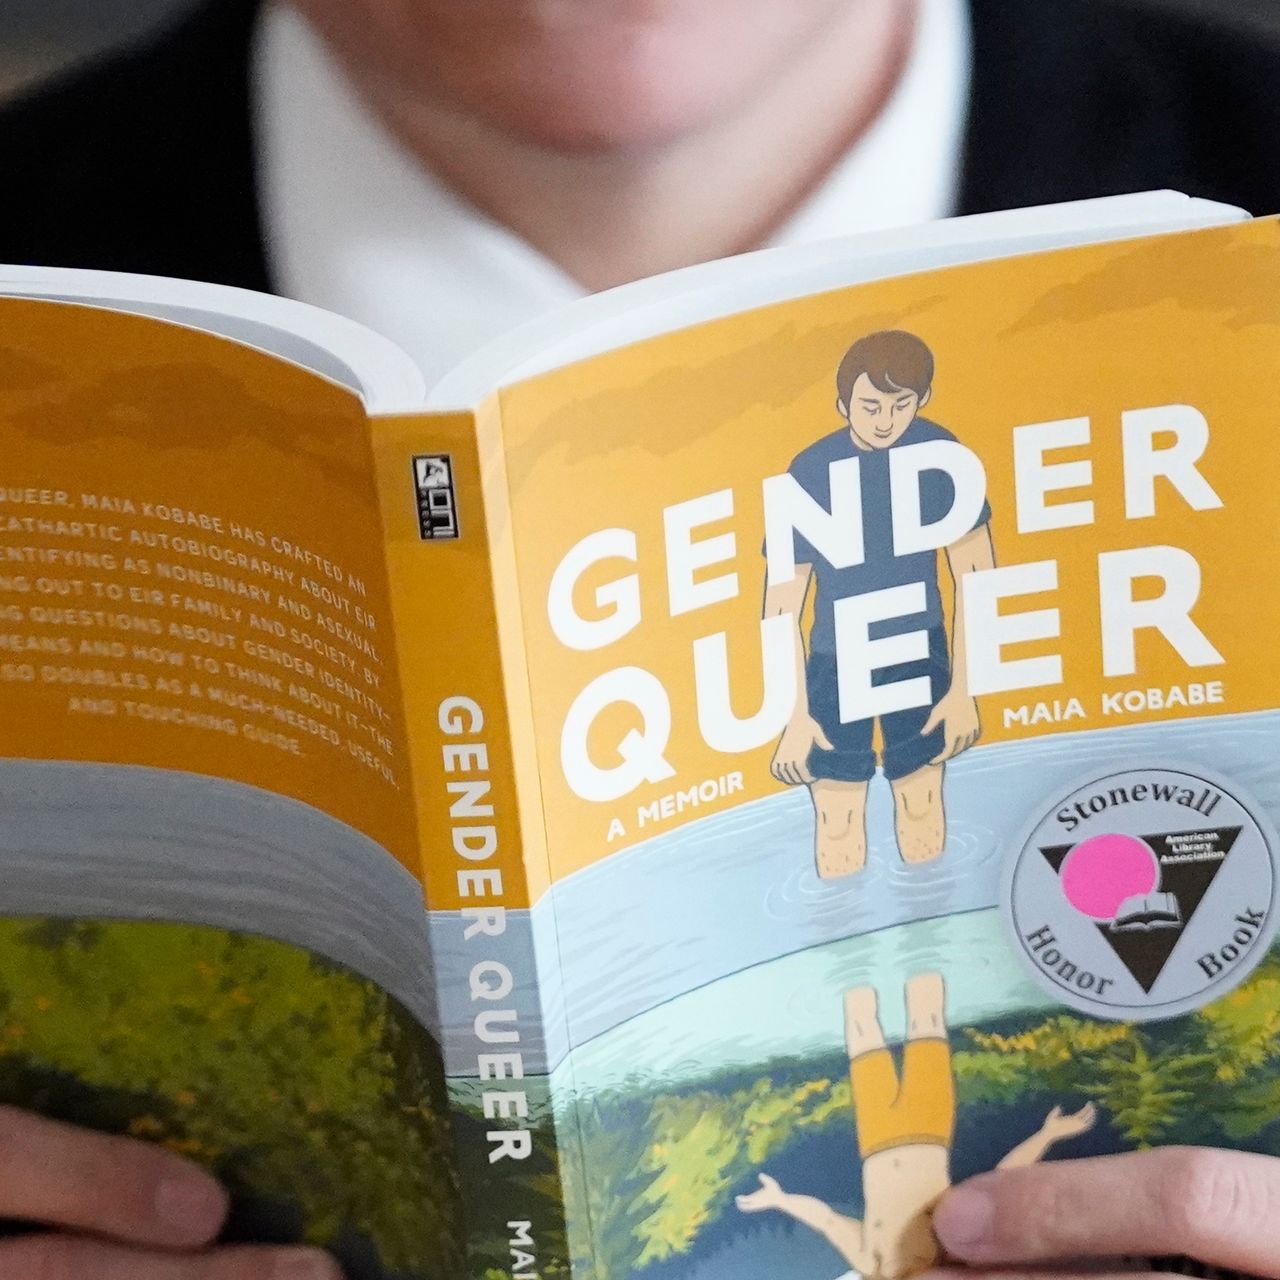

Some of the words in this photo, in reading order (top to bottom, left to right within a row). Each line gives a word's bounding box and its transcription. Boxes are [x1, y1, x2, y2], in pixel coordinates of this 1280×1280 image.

[81, 493, 135, 514] MAIA
[141, 502, 224, 534] KOBABE
[230, 522, 266, 547] HAS
[270, 535, 343, 582] CRAFTED
[347, 573, 366, 597] AN
[547, 403, 1224, 652] GENDER
[124, 557, 151, 576] AS
[155, 561, 271, 604] NONBINARY
[277, 595, 312, 621] AND
[130, 528, 295, 585] AUTOBIOGRAPHY
[300, 576, 352, 614] ABOUT
[354, 605, 376, 631] EIR
[29, 605, 162, 635] QUESTIONS
[169, 621, 237, 650] ABOUT
[243, 640, 316, 679] GENDER
[36, 576, 83, 596] OUT
[92, 581, 123, 600] TO
[129, 585, 165, 606] EIR
[170, 593, 242, 623] FAMILY
[249, 612, 286, 638] AND
[363, 667, 382, 689] BY
[132, 644, 183, 667] HOW
[192, 653, 220, 674] TO
[224, 661, 284, 692] THINK
[288, 683, 342, 721] ABOUT
[155, 675, 183, 695] AS
[190, 681, 201, 698] A
[559, 544, 1227, 802] QUEER
[1001, 699, 1086, 729] MAIA
[1101, 680, 1226, 718] KOBABE
[124, 701, 238, 736] TOUCHING
[438, 695, 507, 941] GENDER
[606, 818, 626, 842] A
[636, 771, 744, 829] MEMOIR
[1056, 783, 1222, 832] Stonewall
[1165, 832, 1219, 845] American
[1160, 851, 1225, 865] Association
[1172, 842, 1212, 854] Library
[1026, 924, 1114, 995] Honor
[1196, 906, 1265, 980] Book
[469, 961, 532, 1164] QUEER
